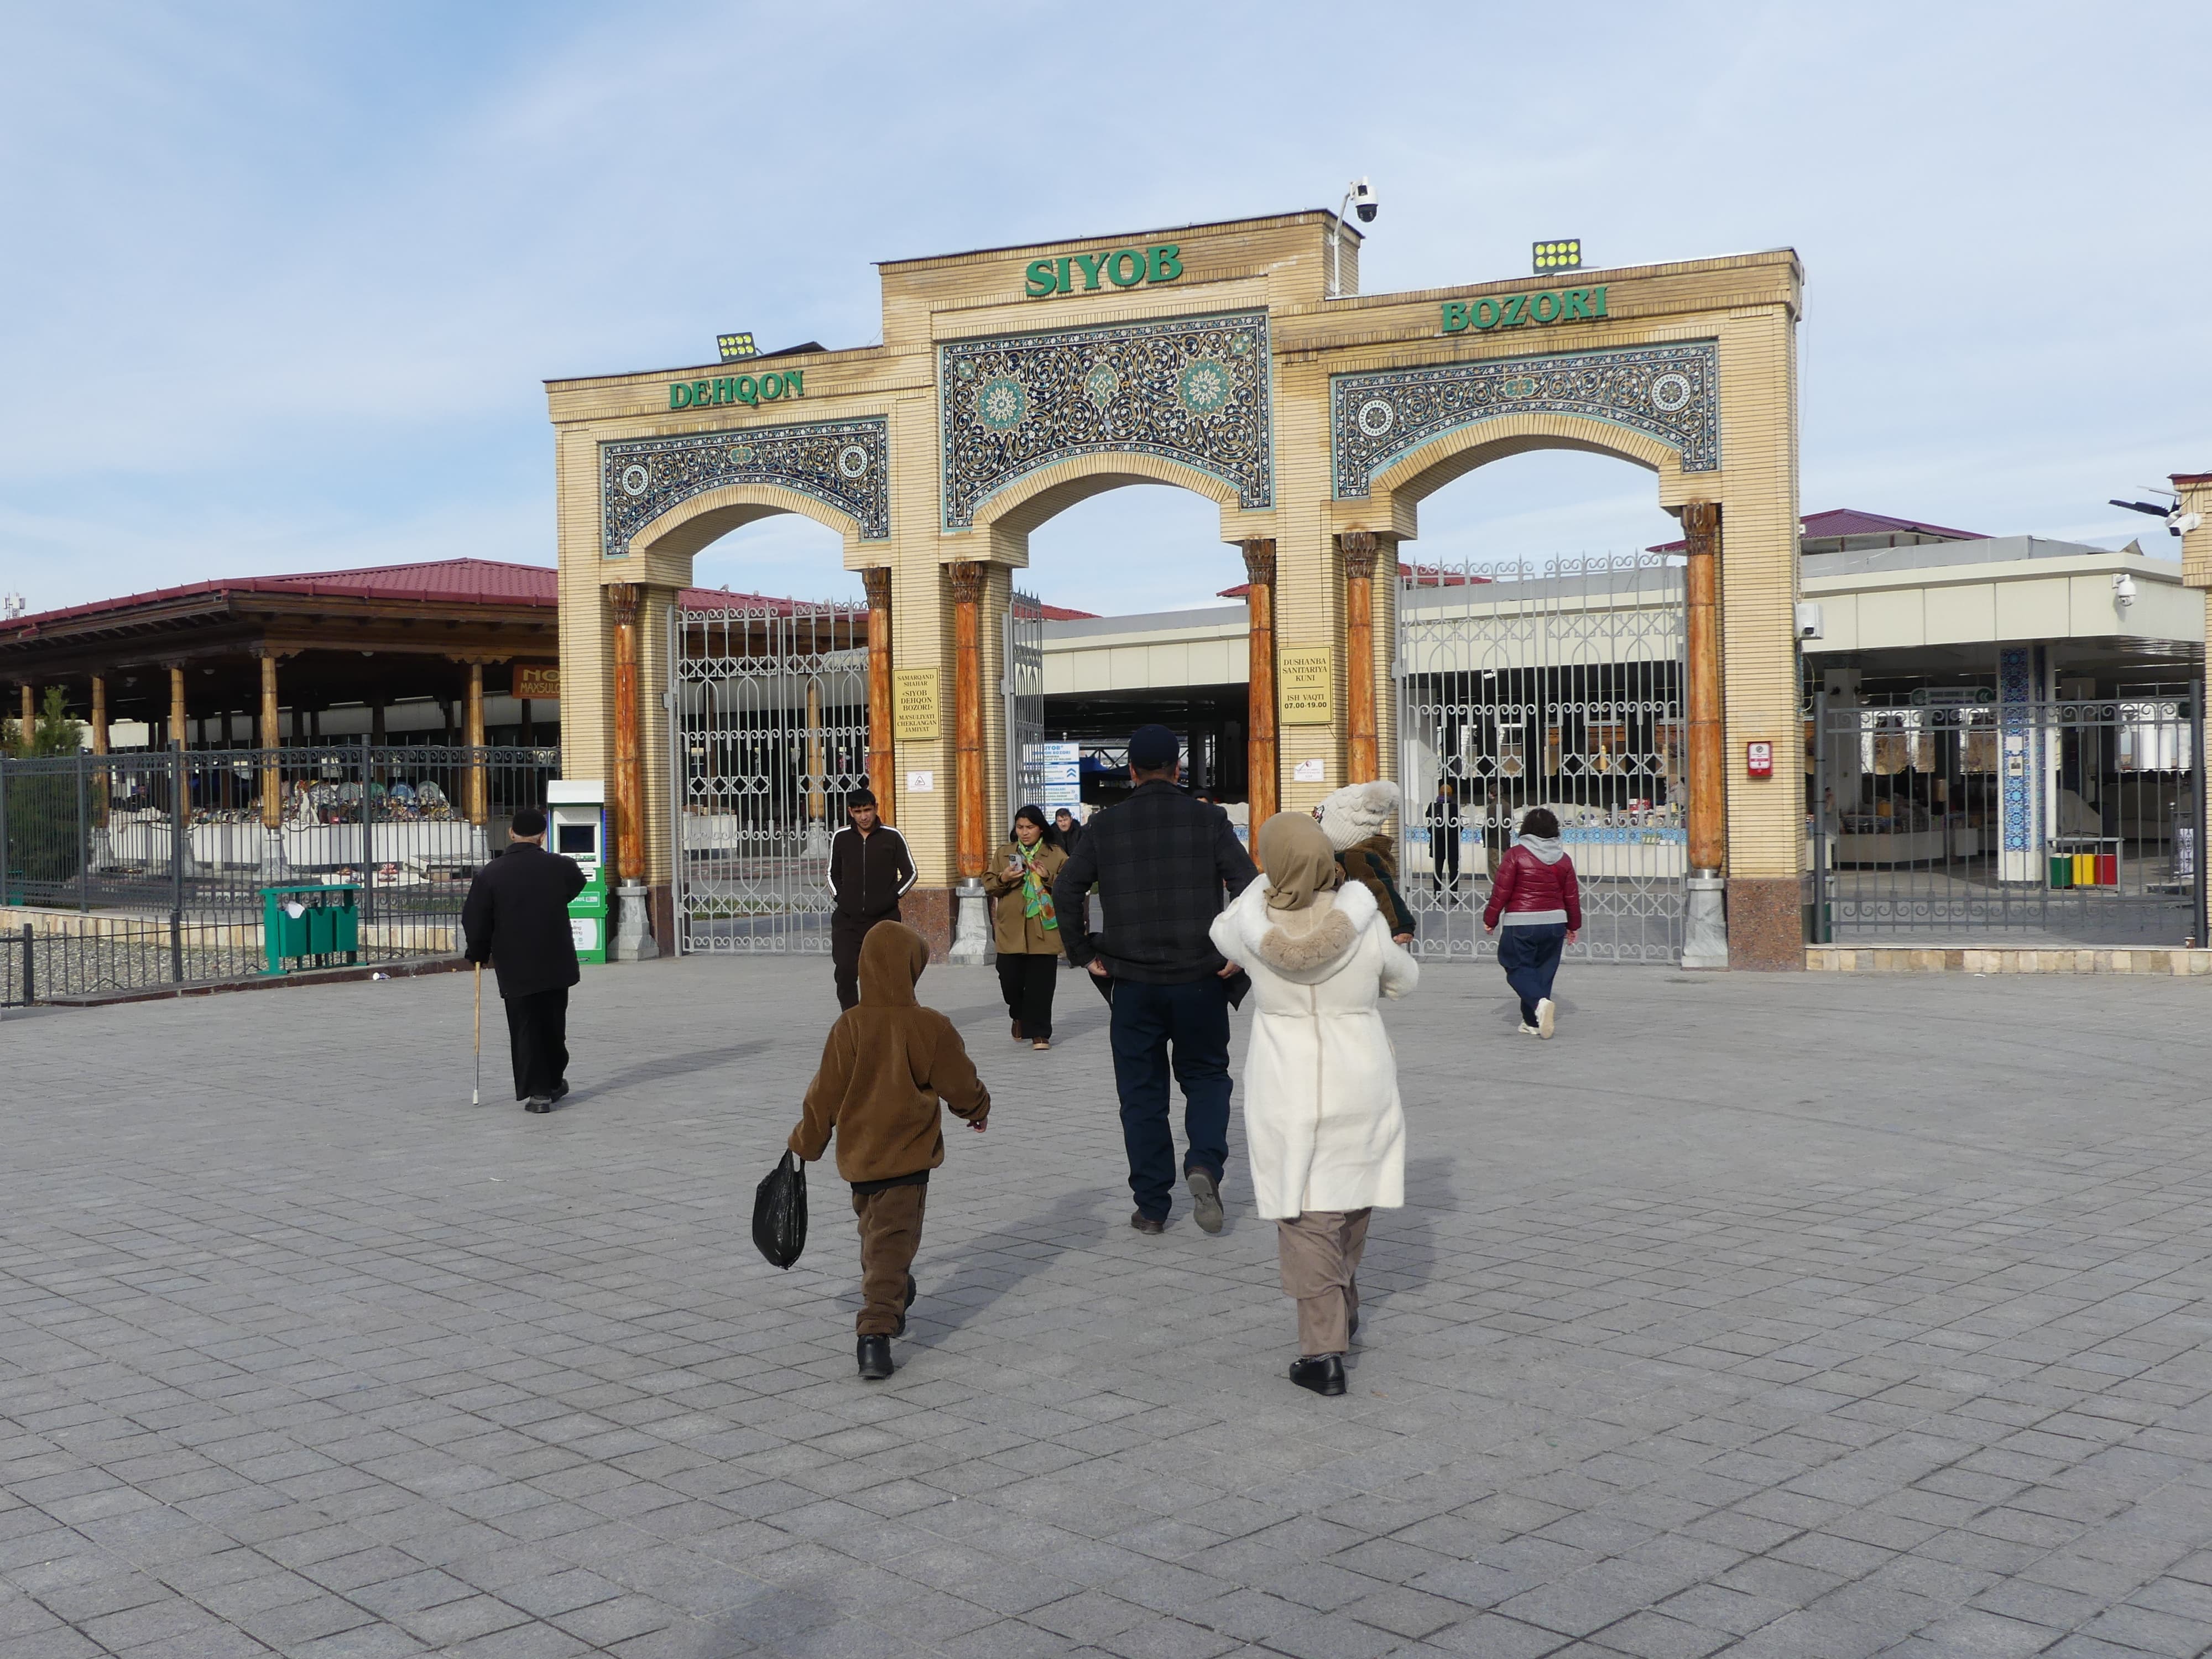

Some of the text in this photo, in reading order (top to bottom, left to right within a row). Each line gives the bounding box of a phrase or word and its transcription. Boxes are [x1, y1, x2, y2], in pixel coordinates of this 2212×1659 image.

[1025, 244, 1183, 296] SIYOB
[1442, 286, 1607, 332] BOZORI
[670, 370, 804, 408] DEHQON
